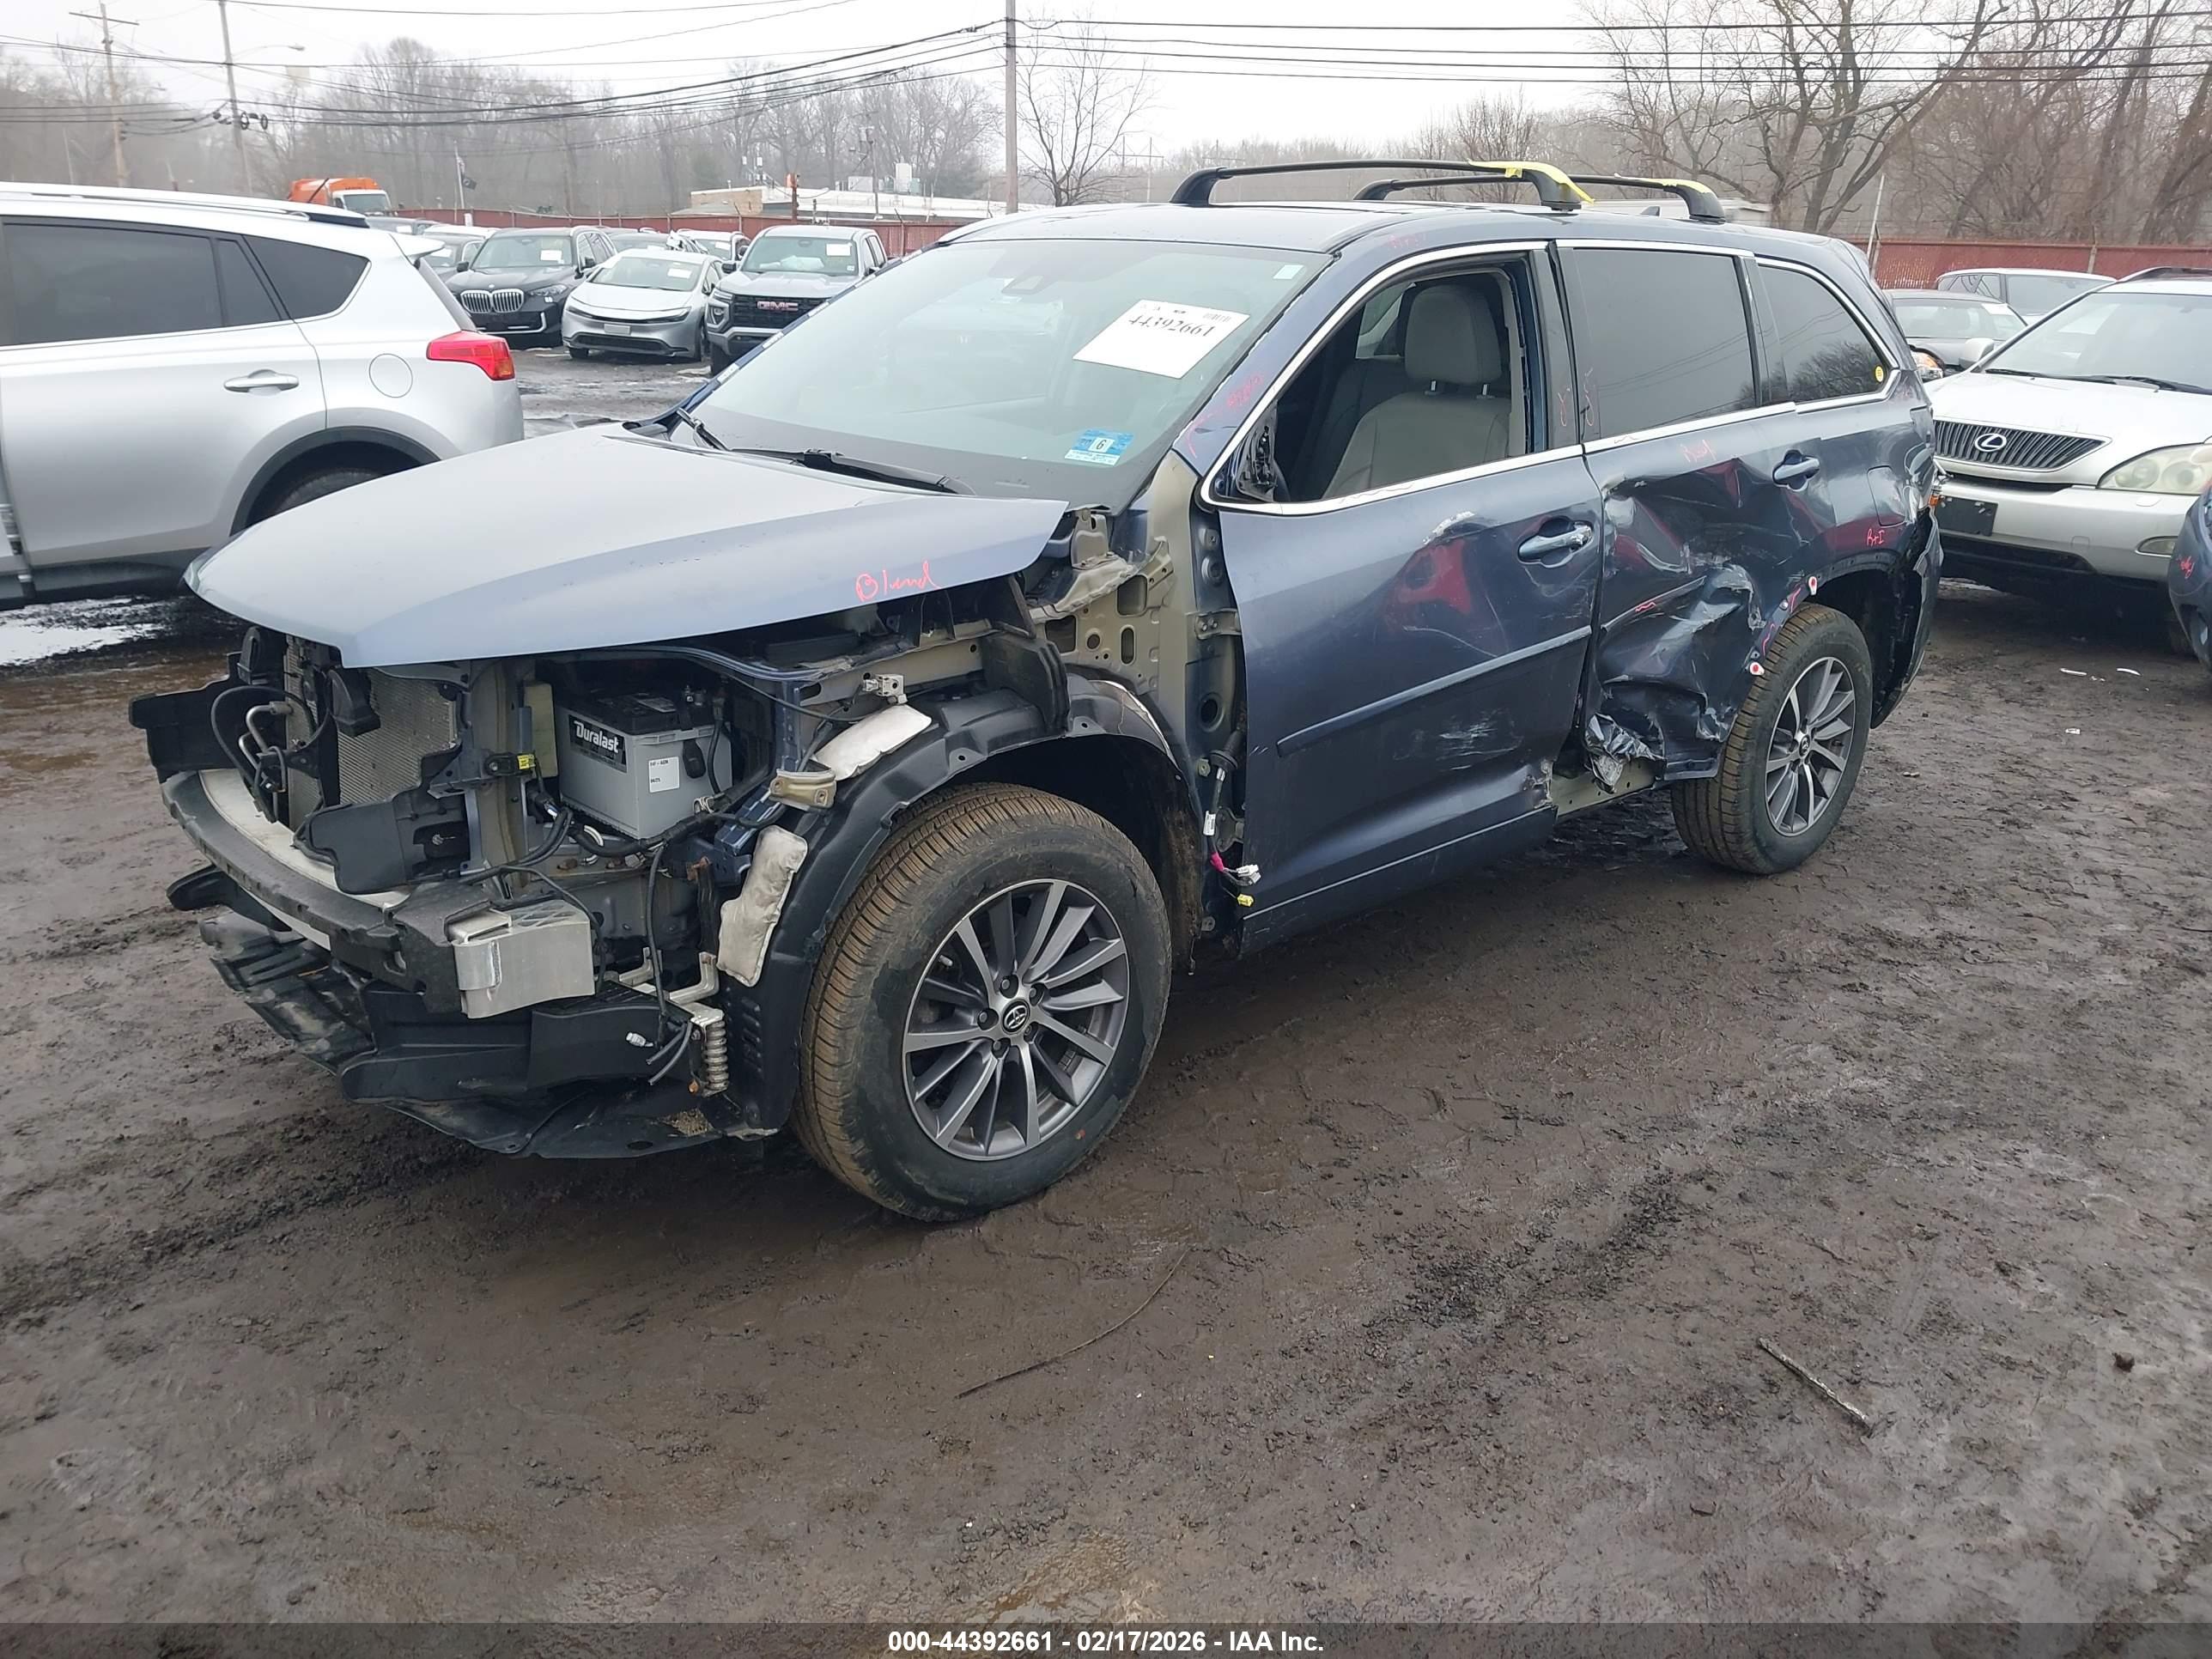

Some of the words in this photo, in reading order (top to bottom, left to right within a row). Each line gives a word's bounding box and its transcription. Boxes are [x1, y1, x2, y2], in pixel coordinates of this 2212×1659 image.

[757, 301, 799, 311] GMC
[1128, 314, 1215, 337] 44392661
[1096, 439, 1107, 450] 6
[574, 720, 619, 754] Duralast
